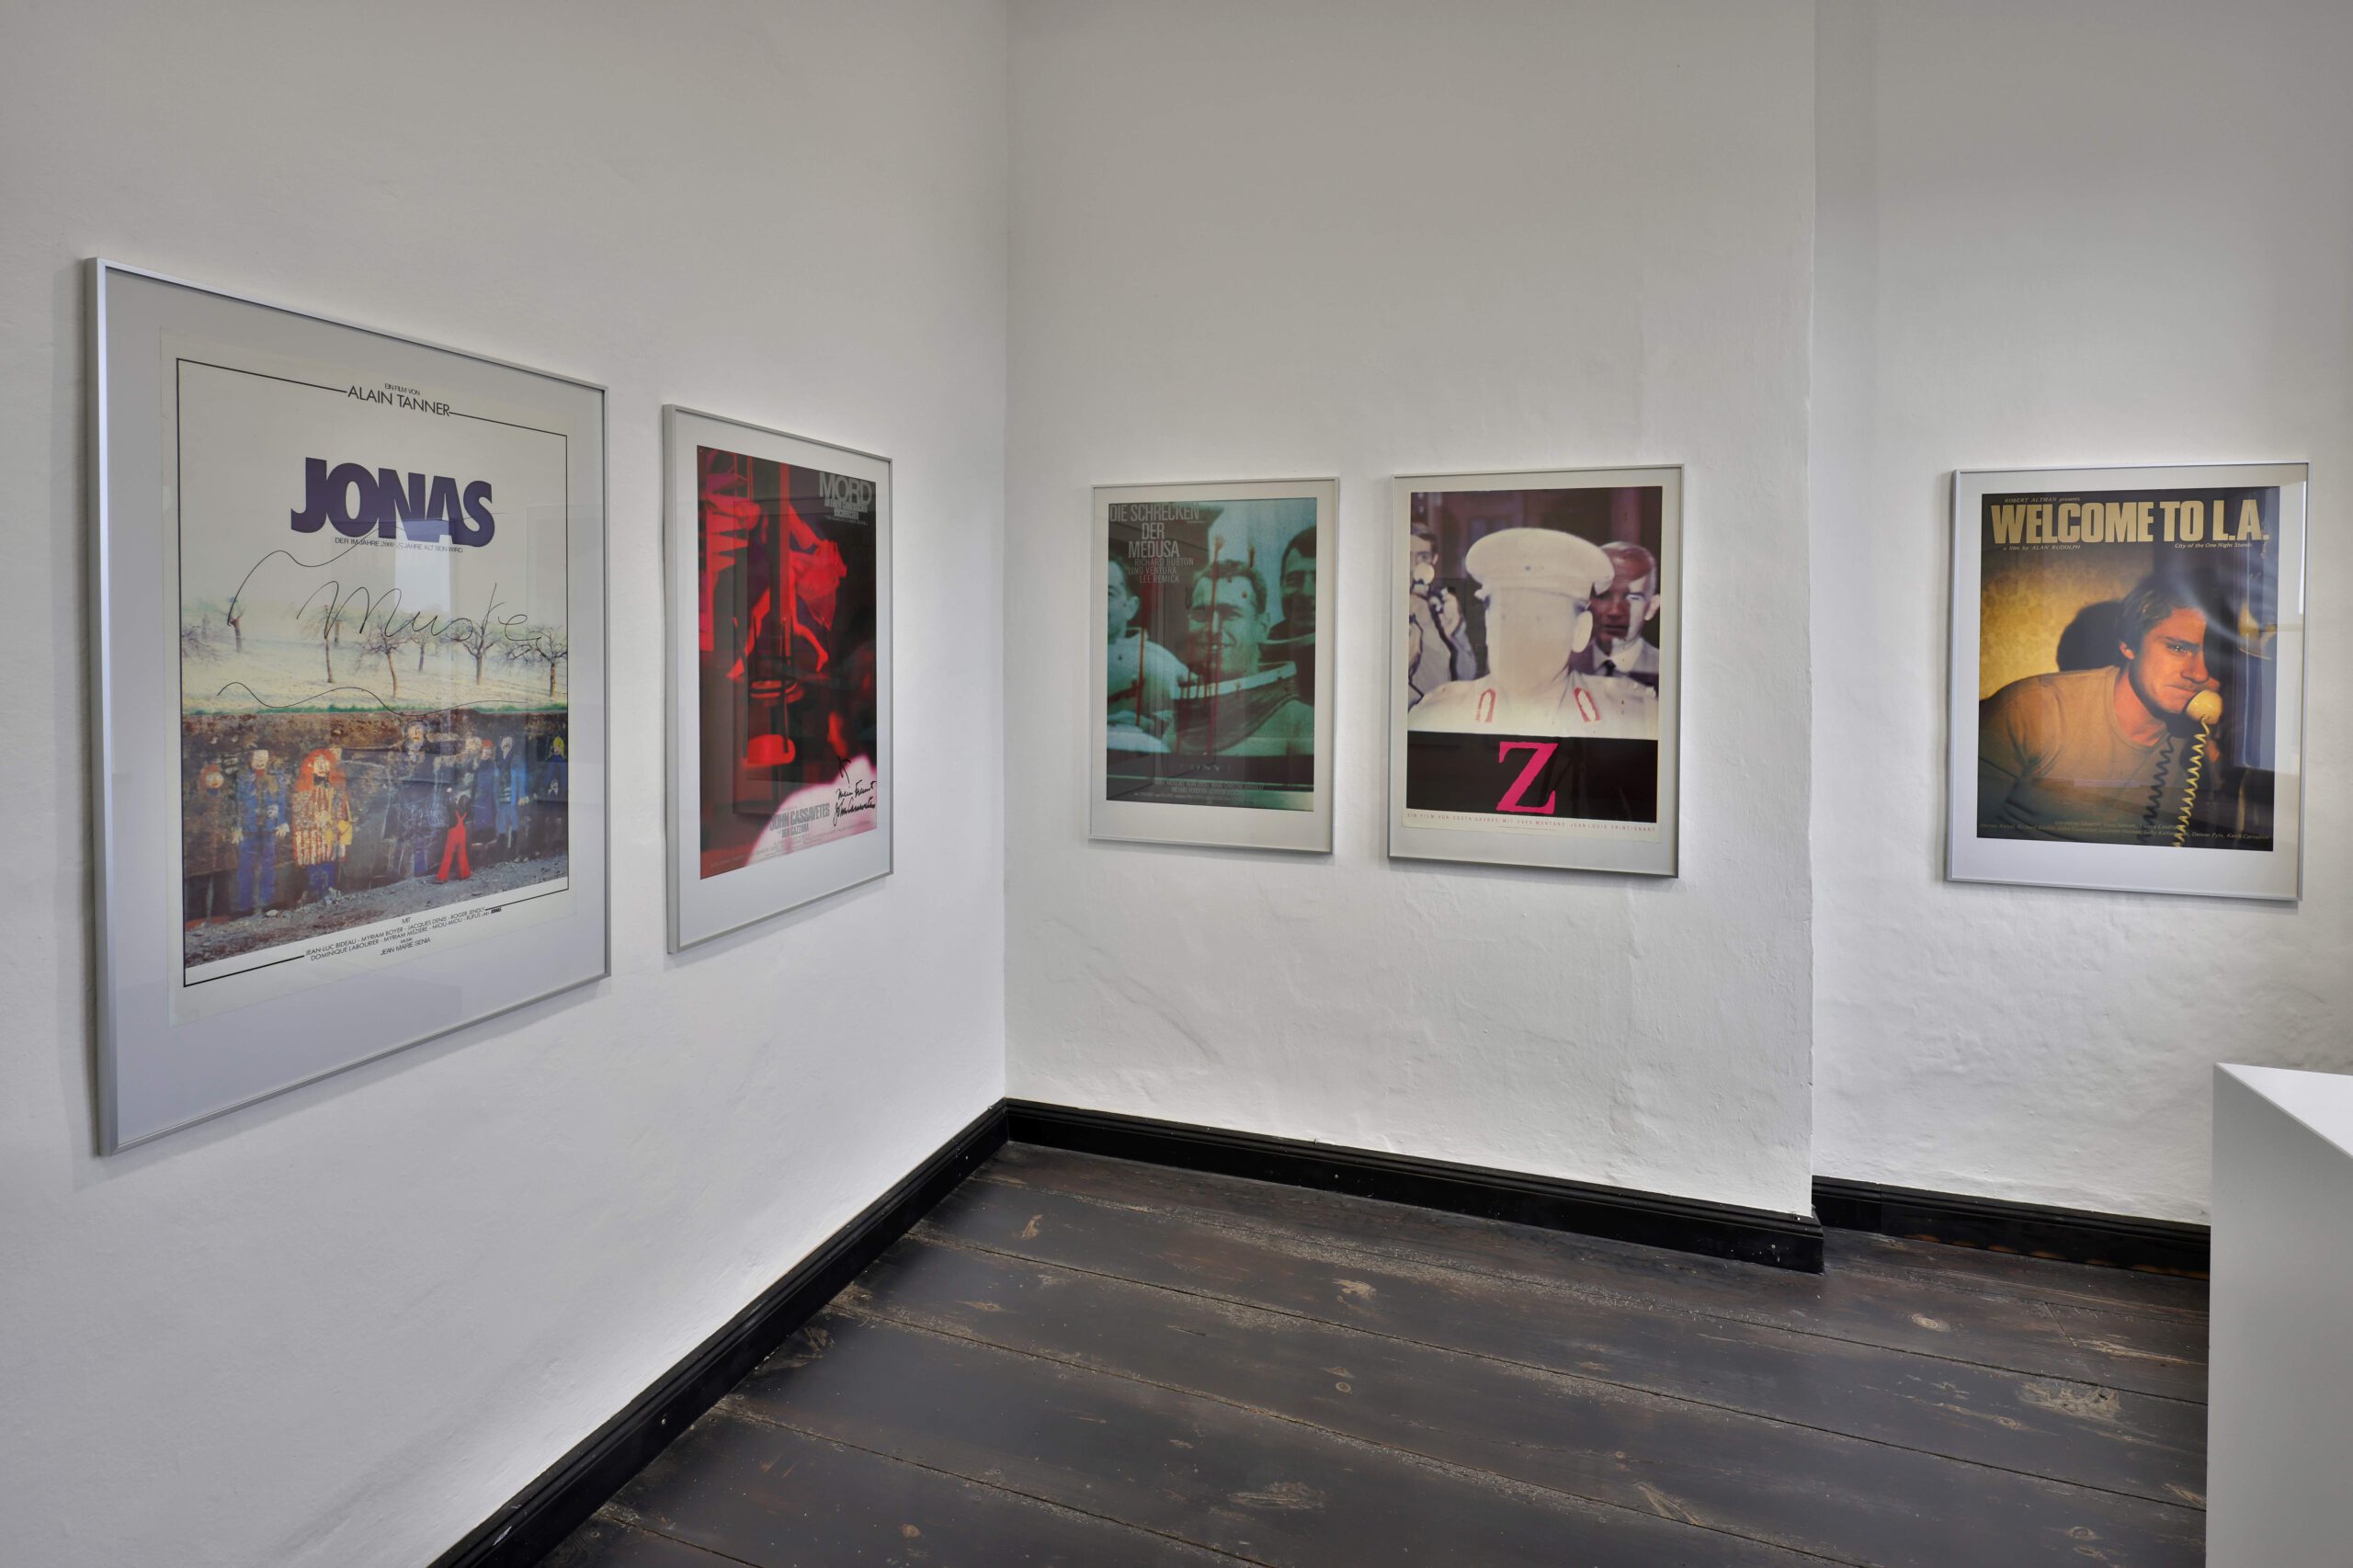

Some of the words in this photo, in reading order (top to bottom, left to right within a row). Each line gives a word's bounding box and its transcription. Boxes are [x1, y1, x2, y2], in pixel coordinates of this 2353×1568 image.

[384, 382, 394, 391] EIN
[394, 385, 409, 393] FILM
[409, 388, 421, 396] VON
[347, 385, 393, 405] ALAIN
[396, 393, 450, 417] TANNER
[819, 471, 872, 506] MORD
[290, 456, 496, 549] JONAS
[1109, 504, 1128, 522] DIE
[1131, 502, 1199, 522] SCHRECKEN
[1142, 522, 1165, 540] DER
[1990, 501, 2154, 544] WELCOME
[2159, 500, 2205, 542] TO
[2212, 499, 2270, 541] L.A.
[335, 537, 349, 545] DER
[358, 539, 380, 547] JAHRE
[404, 542, 423, 551] JAHRE
[424, 543, 434, 551] ALT
[435, 544, 448, 552] SEIN
[1128, 540, 1180, 559] MEDUSA
[1128, 566, 1144, 575] LINO
[1145, 566, 1177, 574] VENTURA
[1134, 558, 1165, 567] RICHARD
[1166, 557, 1194, 566] BURTON
[1140, 574, 1152, 584] LEE
[1153, 574, 1180, 583] REMICK
[1495, 741, 1559, 814] Z
[769, 812, 790, 832] JOHN
[790, 802, 831, 825] CASSAVETES
[305, 944, 335, 957] JEAN-LUC
[335, 938, 357, 949] BIDEAU
[360, 932, 384, 942] MYRIAM
[385, 926, 404, 937] BOYER
[407, 920, 431, 931] JACQUES
[450, 911, 468, 920] ROGER
[311, 948, 348, 961] DOMINIQUE
[348, 938, 380, 952] LABOURIER
[383, 932, 406, 943] MYRIAM
[380, 948, 395, 956] JEAN
[395, 942, 414, 952] MARIE
[415, 937, 431, 948] SENIA
